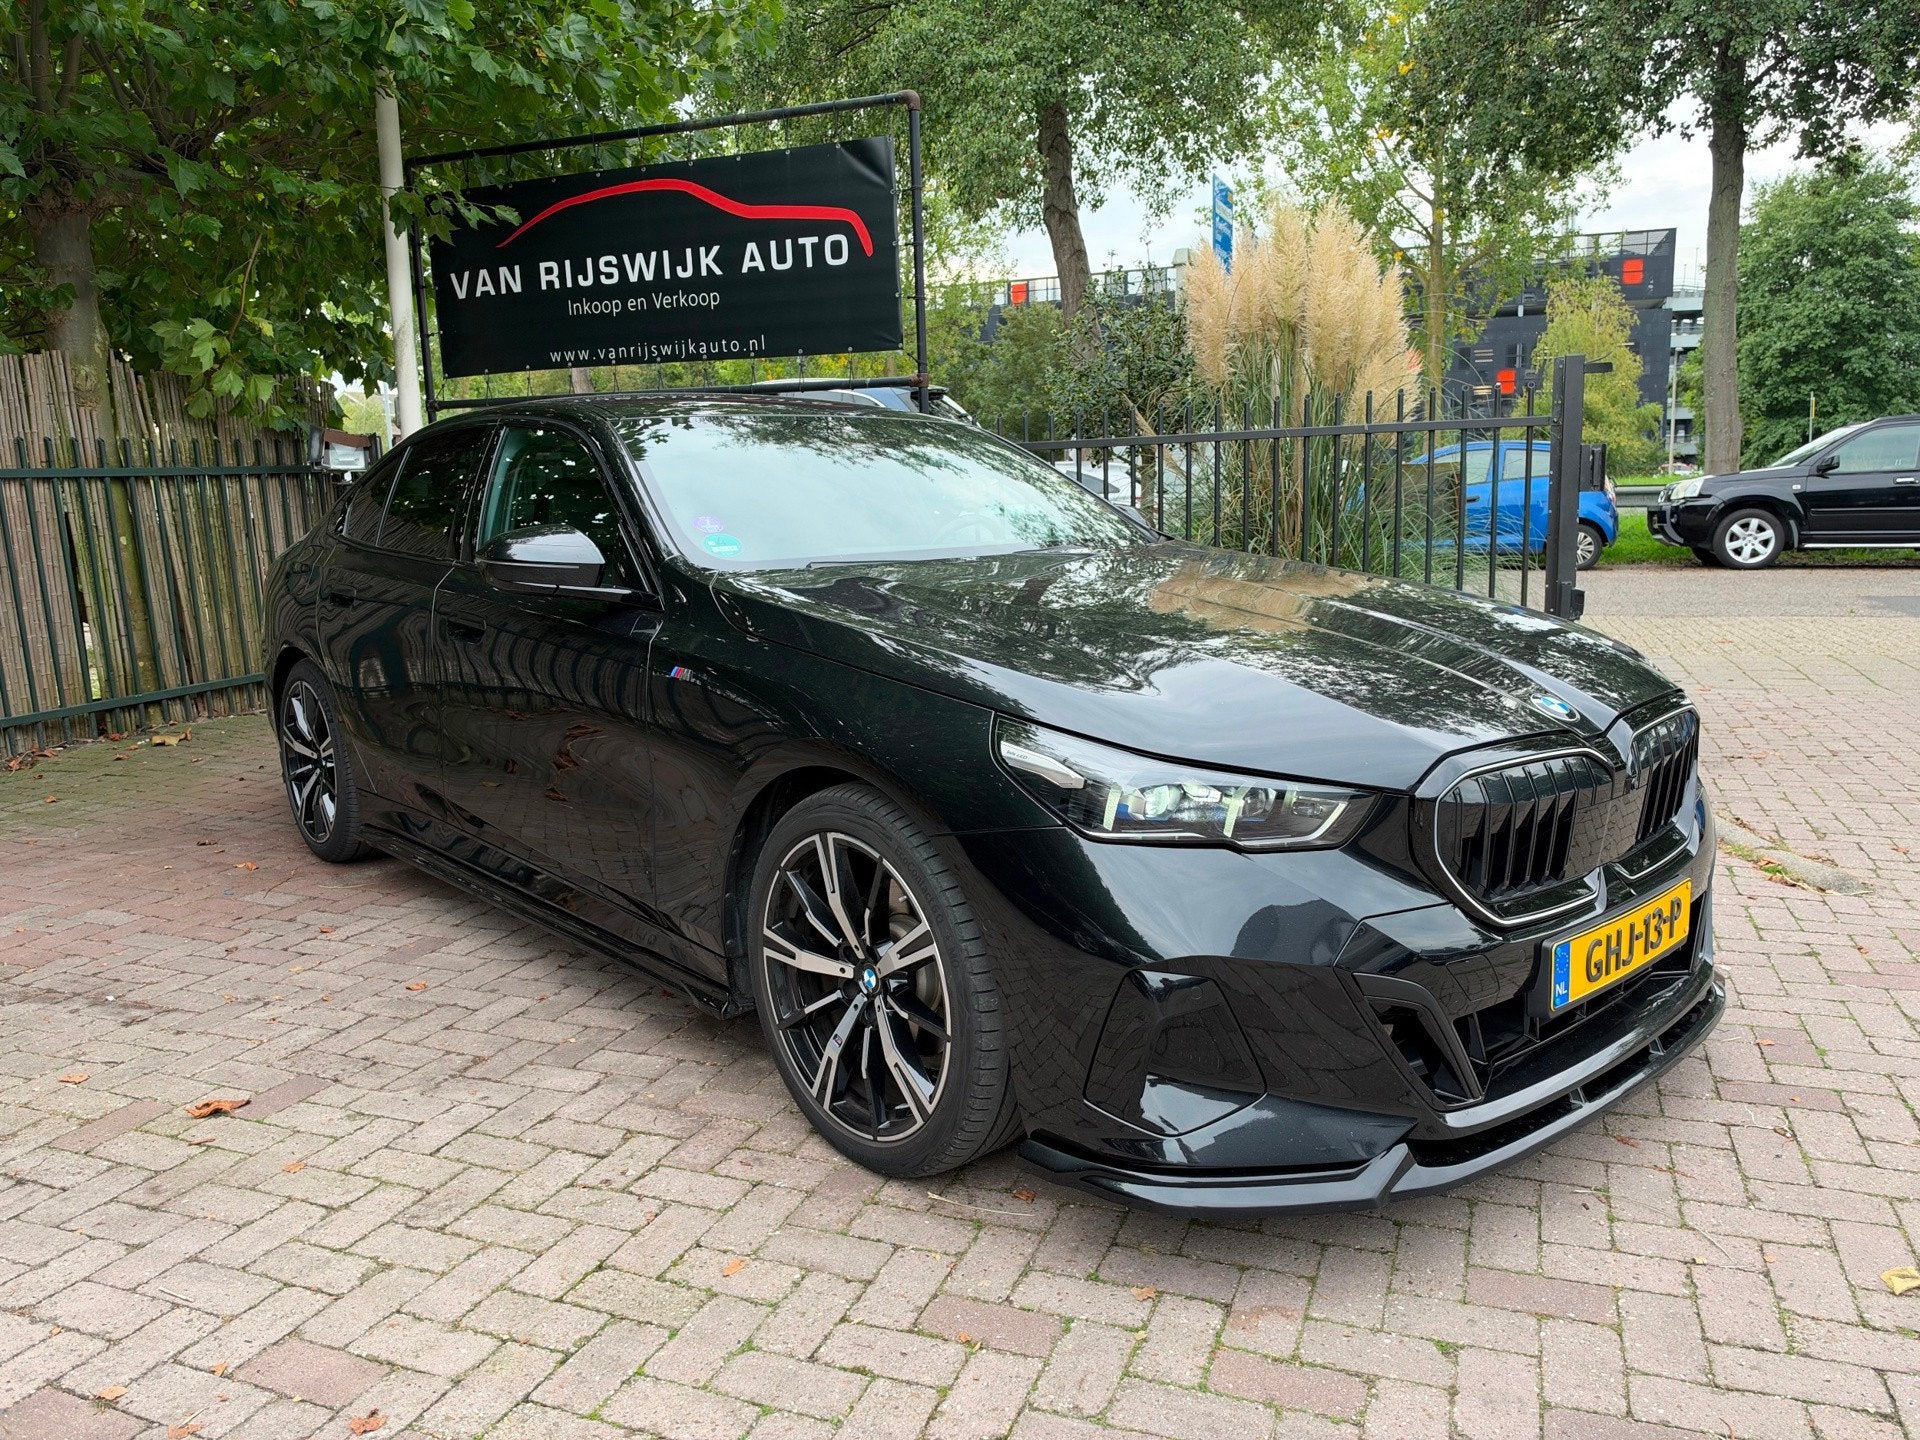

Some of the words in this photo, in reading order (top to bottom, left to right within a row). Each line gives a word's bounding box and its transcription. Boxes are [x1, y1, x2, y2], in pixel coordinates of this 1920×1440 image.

[450, 264, 522, 300] VAN
[539, 245, 723, 290] RIJSWIJK
[741, 234, 849, 274] AUTO
[568, 298, 622, 317] Inkoop
[627, 297, 647, 311] en
[652, 289, 721, 310] Verkoop
[550, 334, 766, 363] www.vanrijswijkauto.nl
[1585, 896, 1683, 983] GHJ-13-P
[1555, 982, 1568, 997] NL
